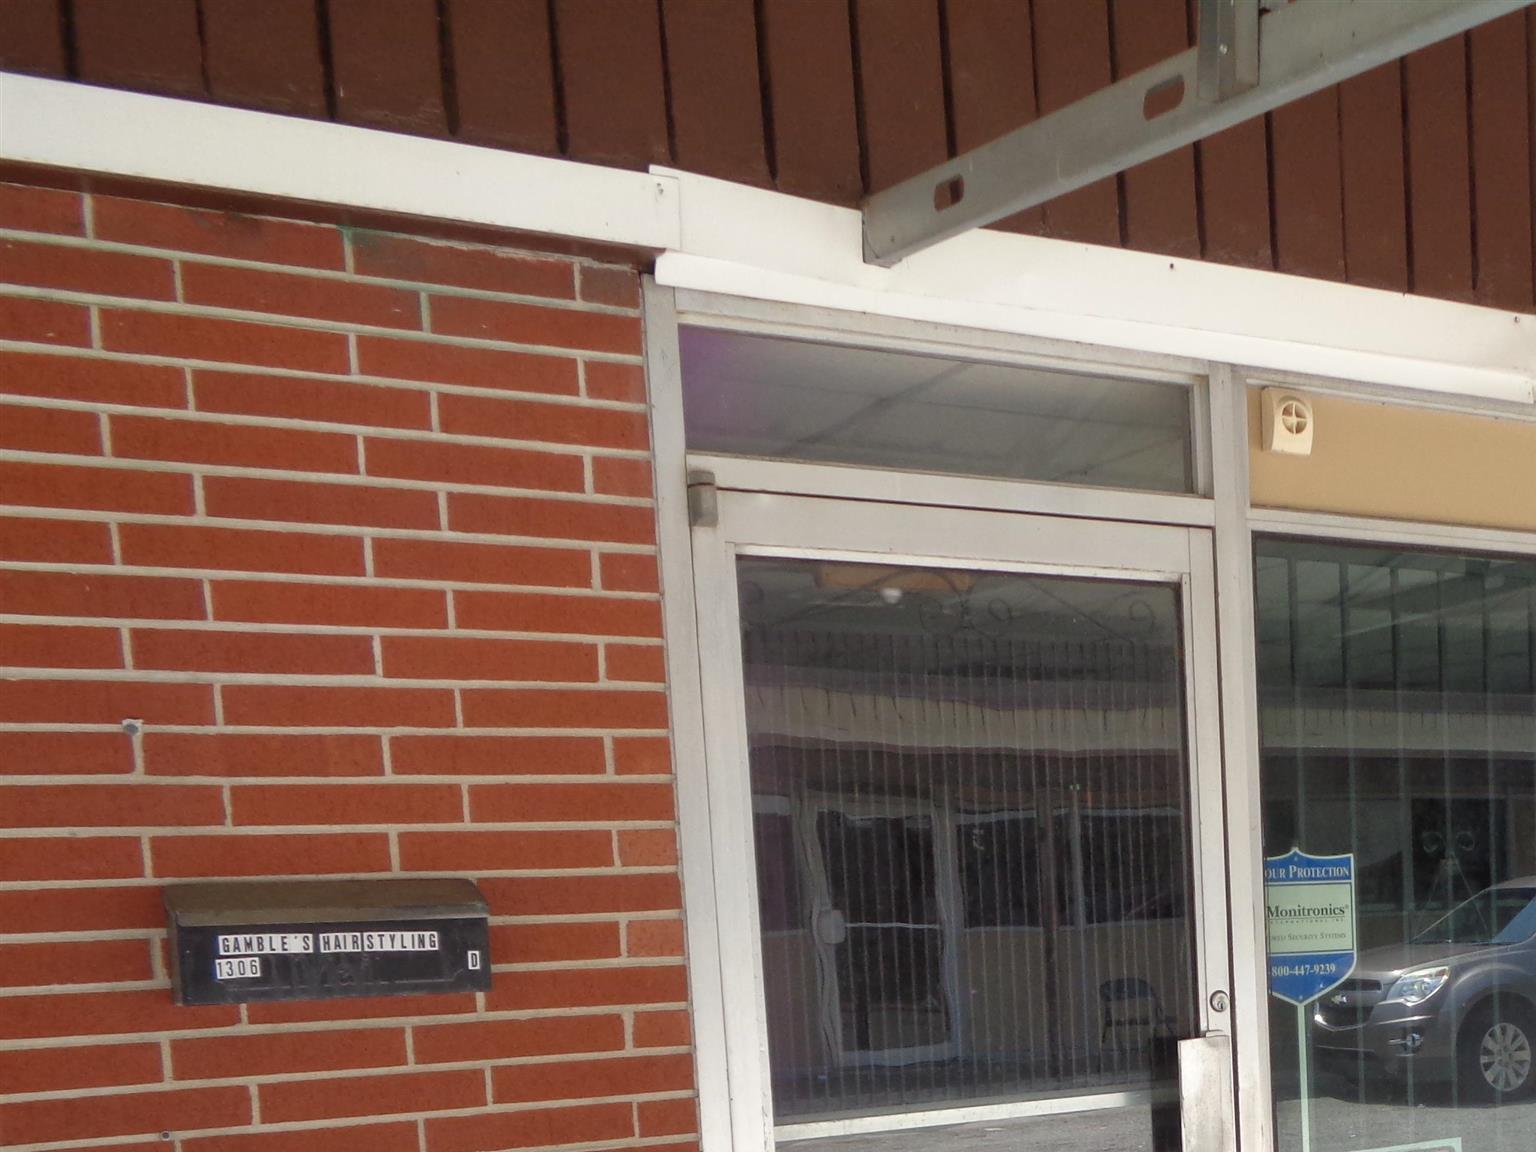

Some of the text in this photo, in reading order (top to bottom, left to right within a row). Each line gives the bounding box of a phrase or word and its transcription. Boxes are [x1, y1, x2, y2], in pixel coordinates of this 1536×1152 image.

[1264, 865, 1349, 879] OUR PROTECTION
[1267, 904, 1345, 918] Monitronics
[222, 935, 311, 953] GAMBLE'S
[217, 959, 259, 977] 1306
[470, 953, 479, 968] D
